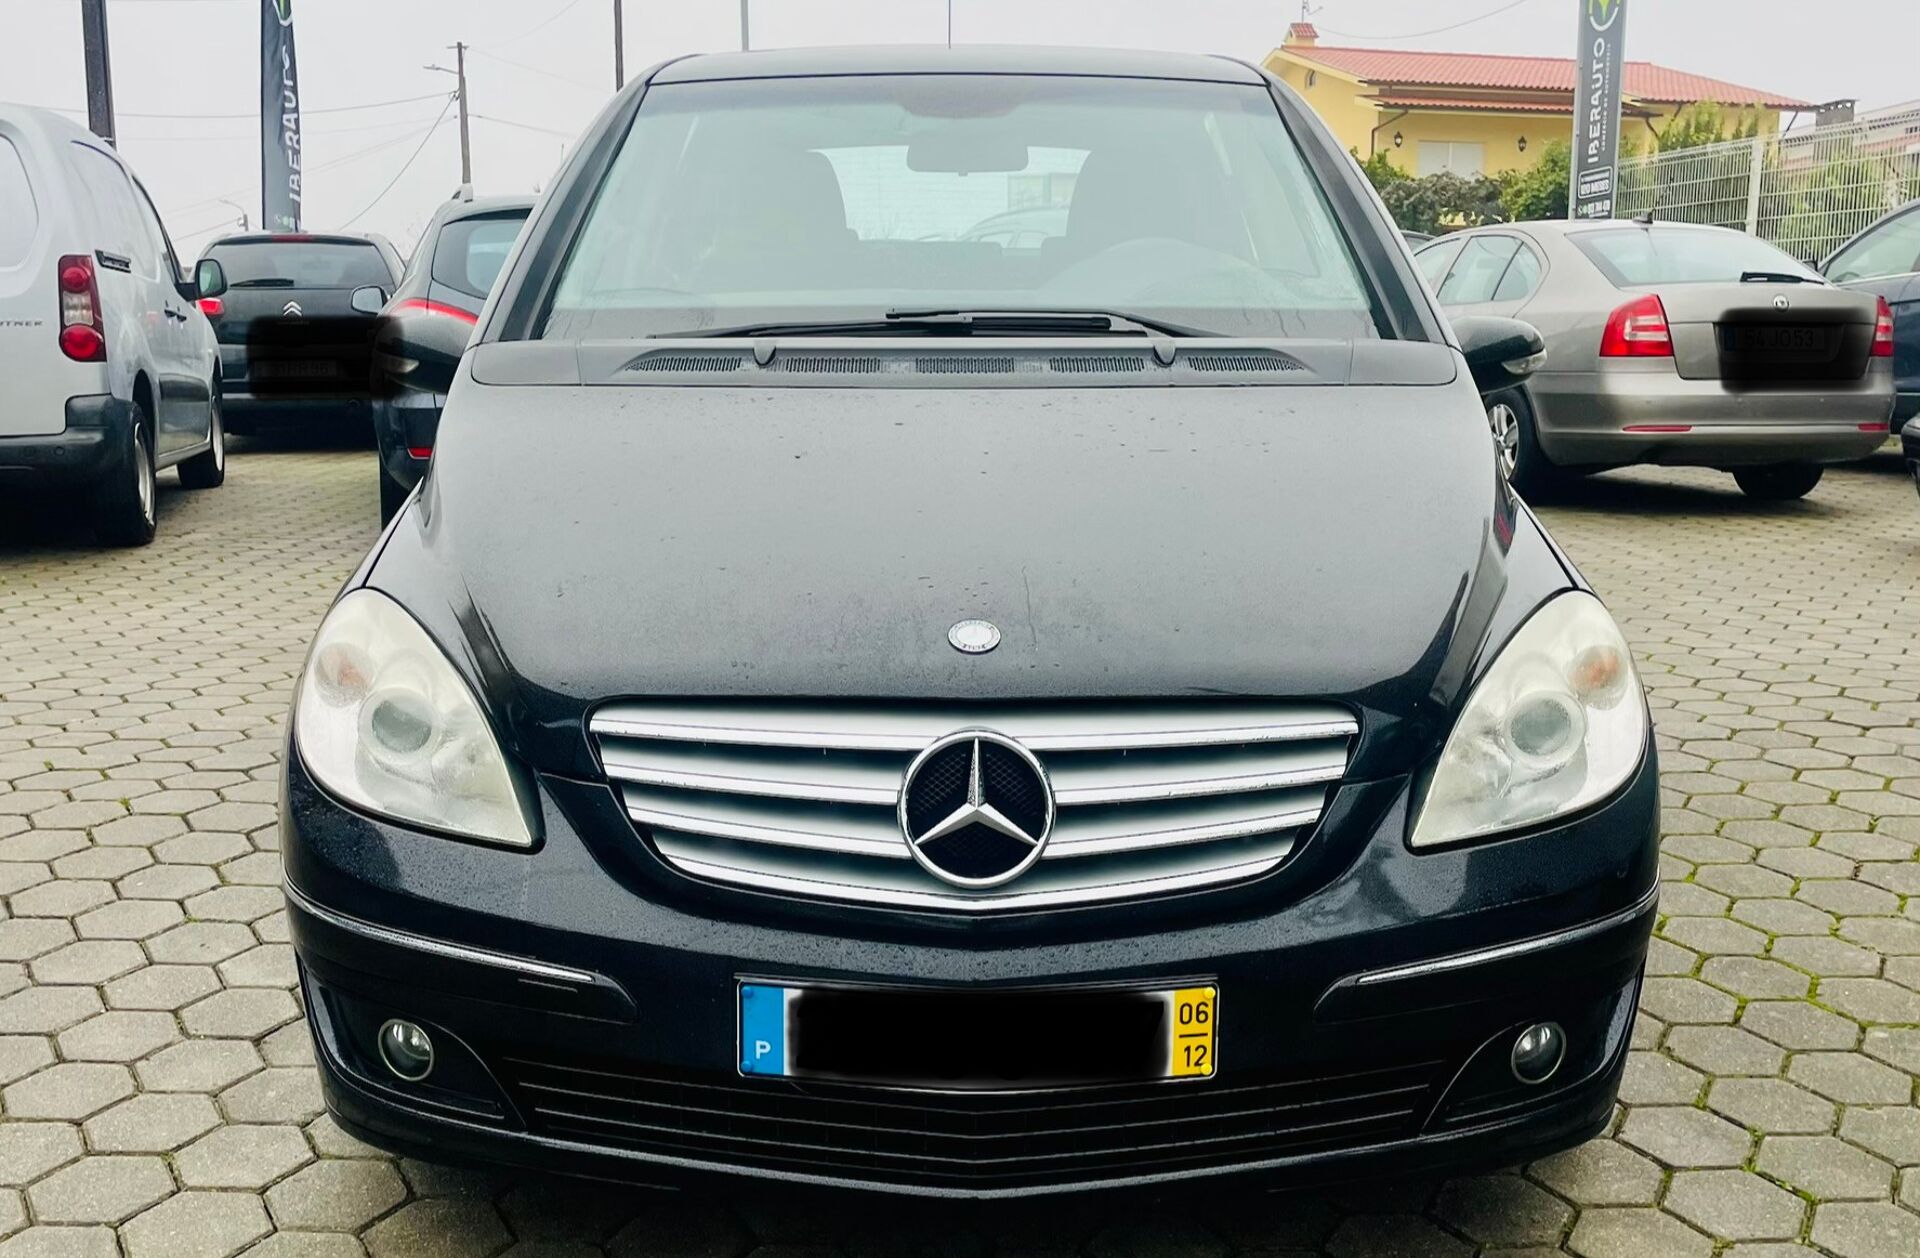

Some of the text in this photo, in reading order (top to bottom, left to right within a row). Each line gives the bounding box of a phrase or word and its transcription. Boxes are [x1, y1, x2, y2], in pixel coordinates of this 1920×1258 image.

[1587, 37, 1605, 164] IBERAUTO
[1179, 1002, 1209, 1025] 06
[755, 1039, 772, 1060] P
[1183, 1044, 1208, 1068] 12
